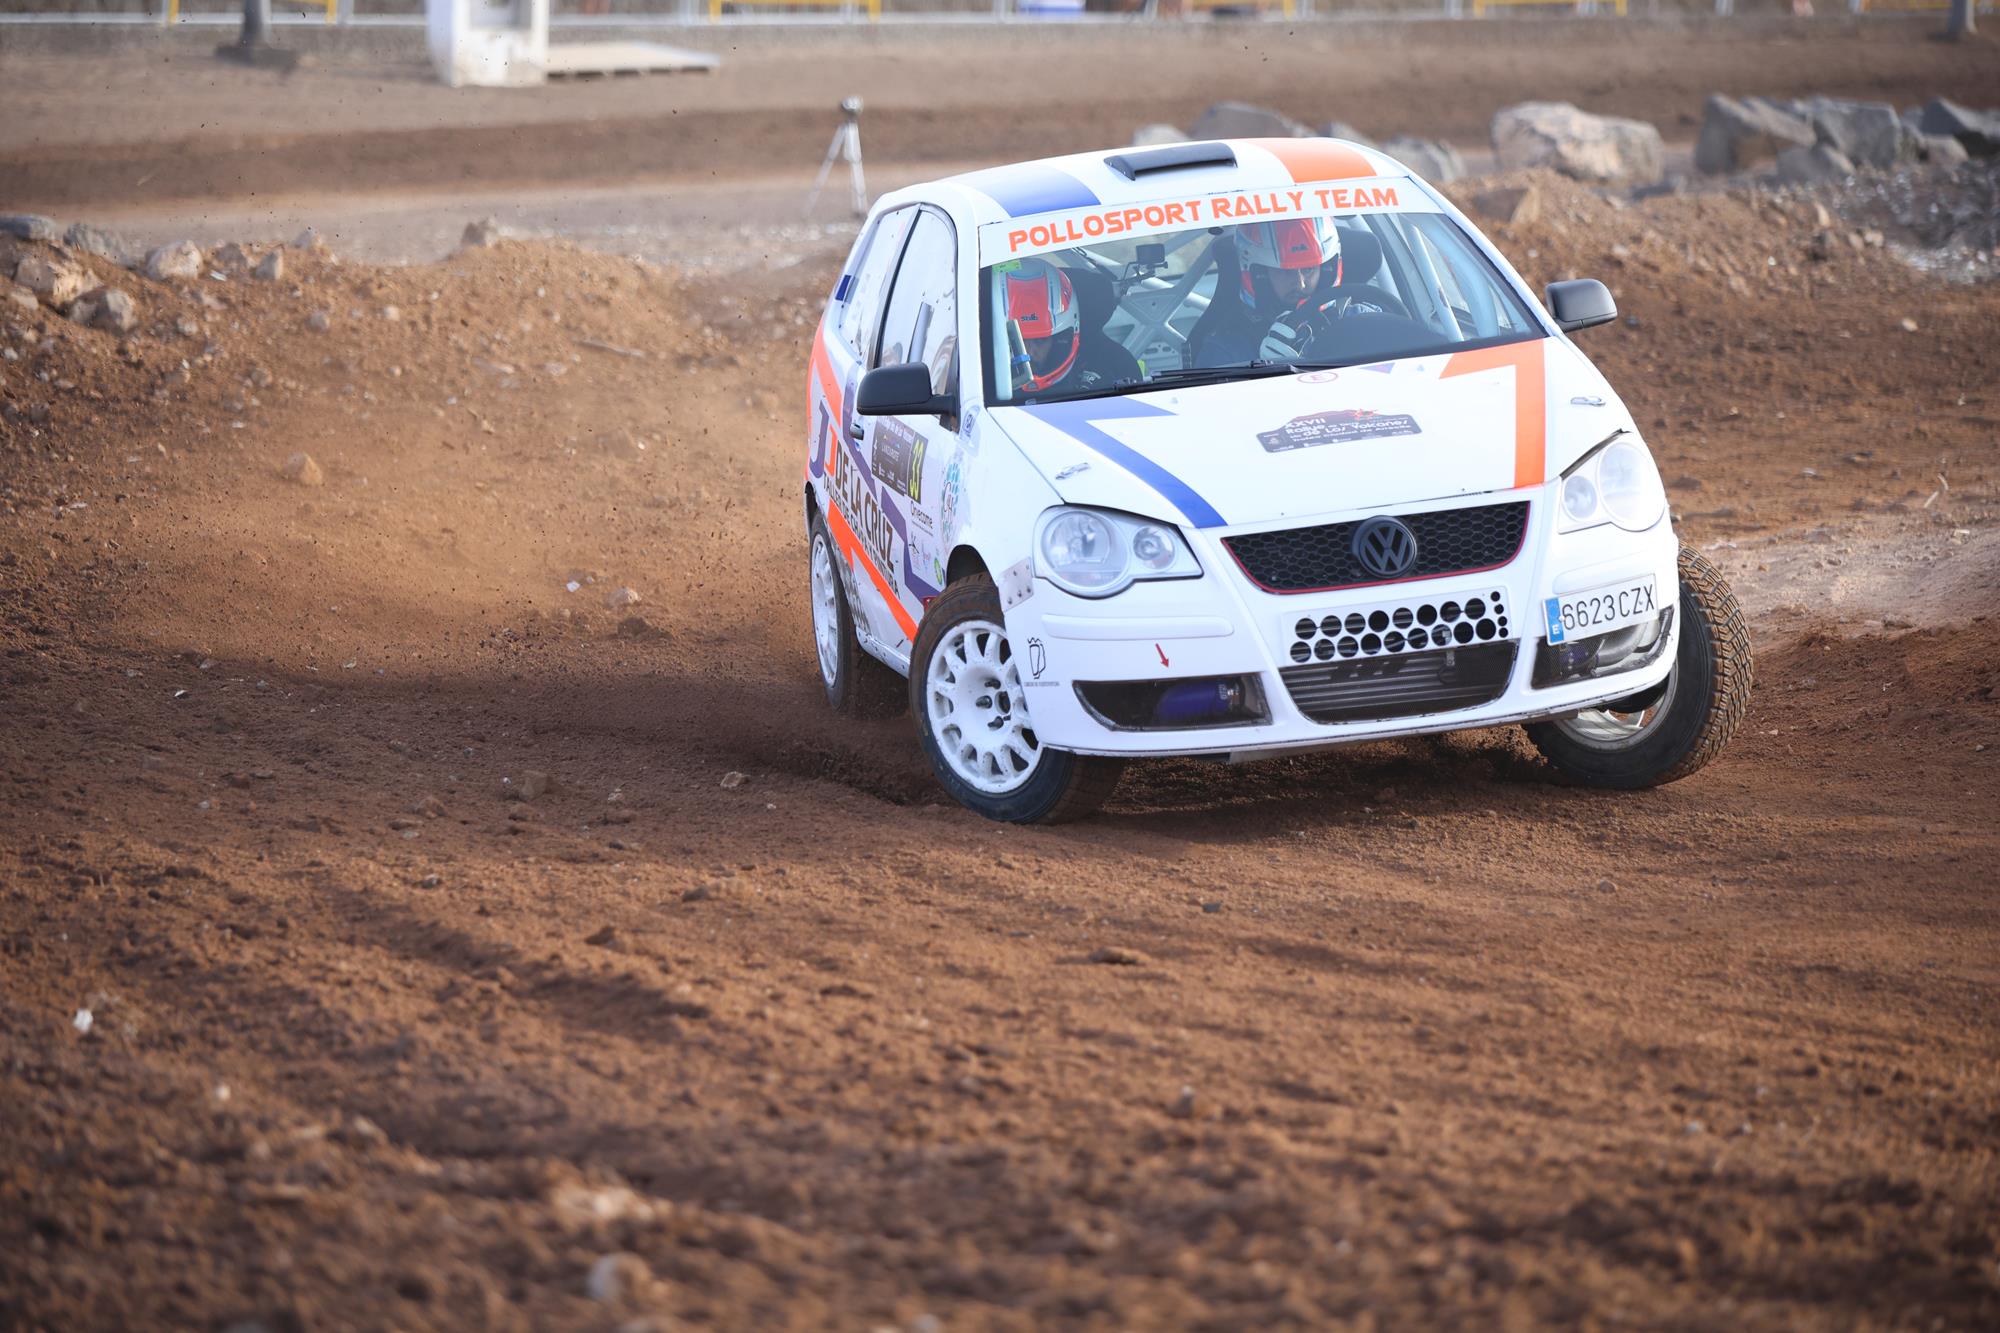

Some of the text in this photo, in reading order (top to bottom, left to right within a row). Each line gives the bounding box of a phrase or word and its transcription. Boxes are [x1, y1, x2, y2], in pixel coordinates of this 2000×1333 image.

[1008, 187, 1398, 253] POLLOSPORT RALLY TEAM
[1285, 417, 1327, 429] XXVII
[909, 439, 924, 500] 33
[835, 440, 849, 502] DE
[851, 465, 864, 528] LA
[864, 489, 896, 574] CRUZ
[1357, 519, 1414, 576] VW
[1551, 623, 1560, 635] E
